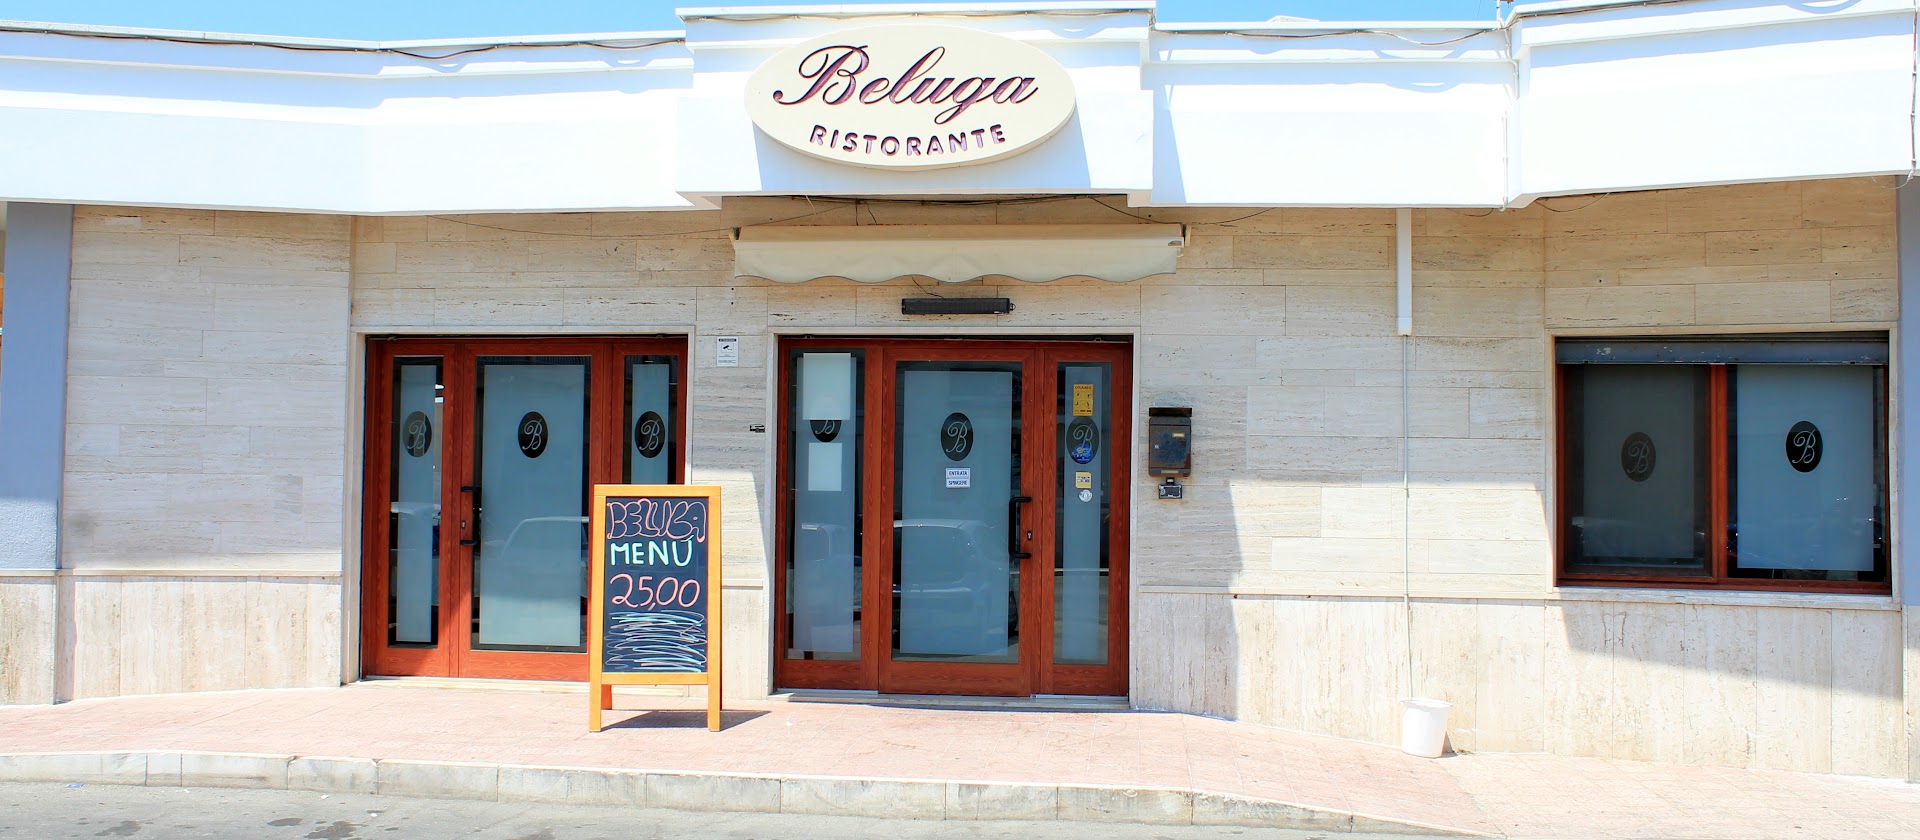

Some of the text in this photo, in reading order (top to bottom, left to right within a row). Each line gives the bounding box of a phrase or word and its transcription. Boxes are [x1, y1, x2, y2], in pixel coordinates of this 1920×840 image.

[773, 45, 1039, 125] Beluga
[809, 124, 1006, 157] RISTORANTE
[521, 419, 543, 450] B
[639, 419, 660, 450] B
[945, 420, 968, 453] B
[1792, 429, 1816, 464] B
[606, 498, 707, 543] BELUGA
[609, 573, 701, 611] 25,00
